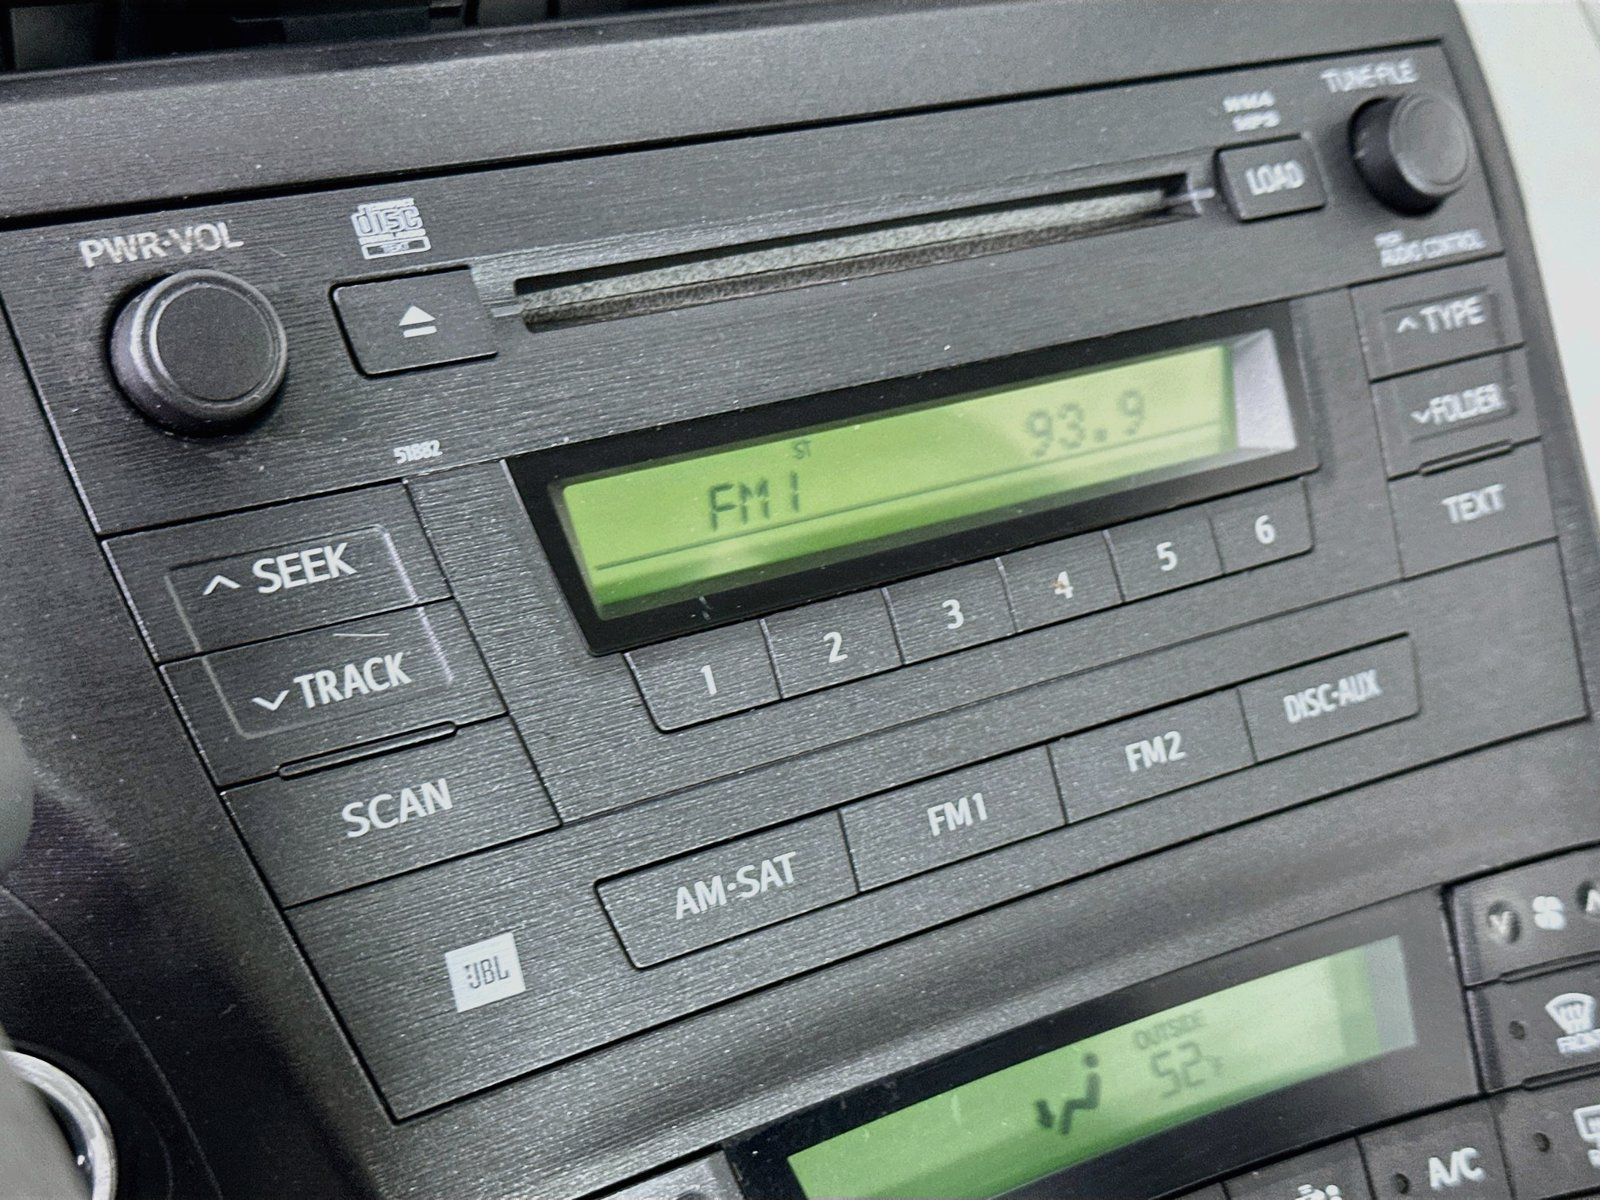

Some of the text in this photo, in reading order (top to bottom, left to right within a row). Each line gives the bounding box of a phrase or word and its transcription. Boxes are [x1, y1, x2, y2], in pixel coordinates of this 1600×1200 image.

[1245, 160, 1305, 196] LOAD
[1420, 295, 1486, 334] TYPE
[1025, 389, 1146, 458] 93.9
[1441, 483, 1505, 524] TEXT
[1254, 514, 1276, 545] 6
[252, 542, 357, 594] SEEK
[1156, 541, 1178, 572] 5
[1052, 570, 1074, 600] 4
[942, 599, 964, 630] 3
[823, 631, 848, 663] 2
[294, 652, 412, 708] TRACK
[700, 664, 717, 696] 1
[1125, 731, 1186, 772] FM2
[341, 778, 453, 838] SCAN
[927, 793, 987, 837] FM1
[464, 956, 509, 990] JBL
[1428, 1147, 1487, 1190] A/C
